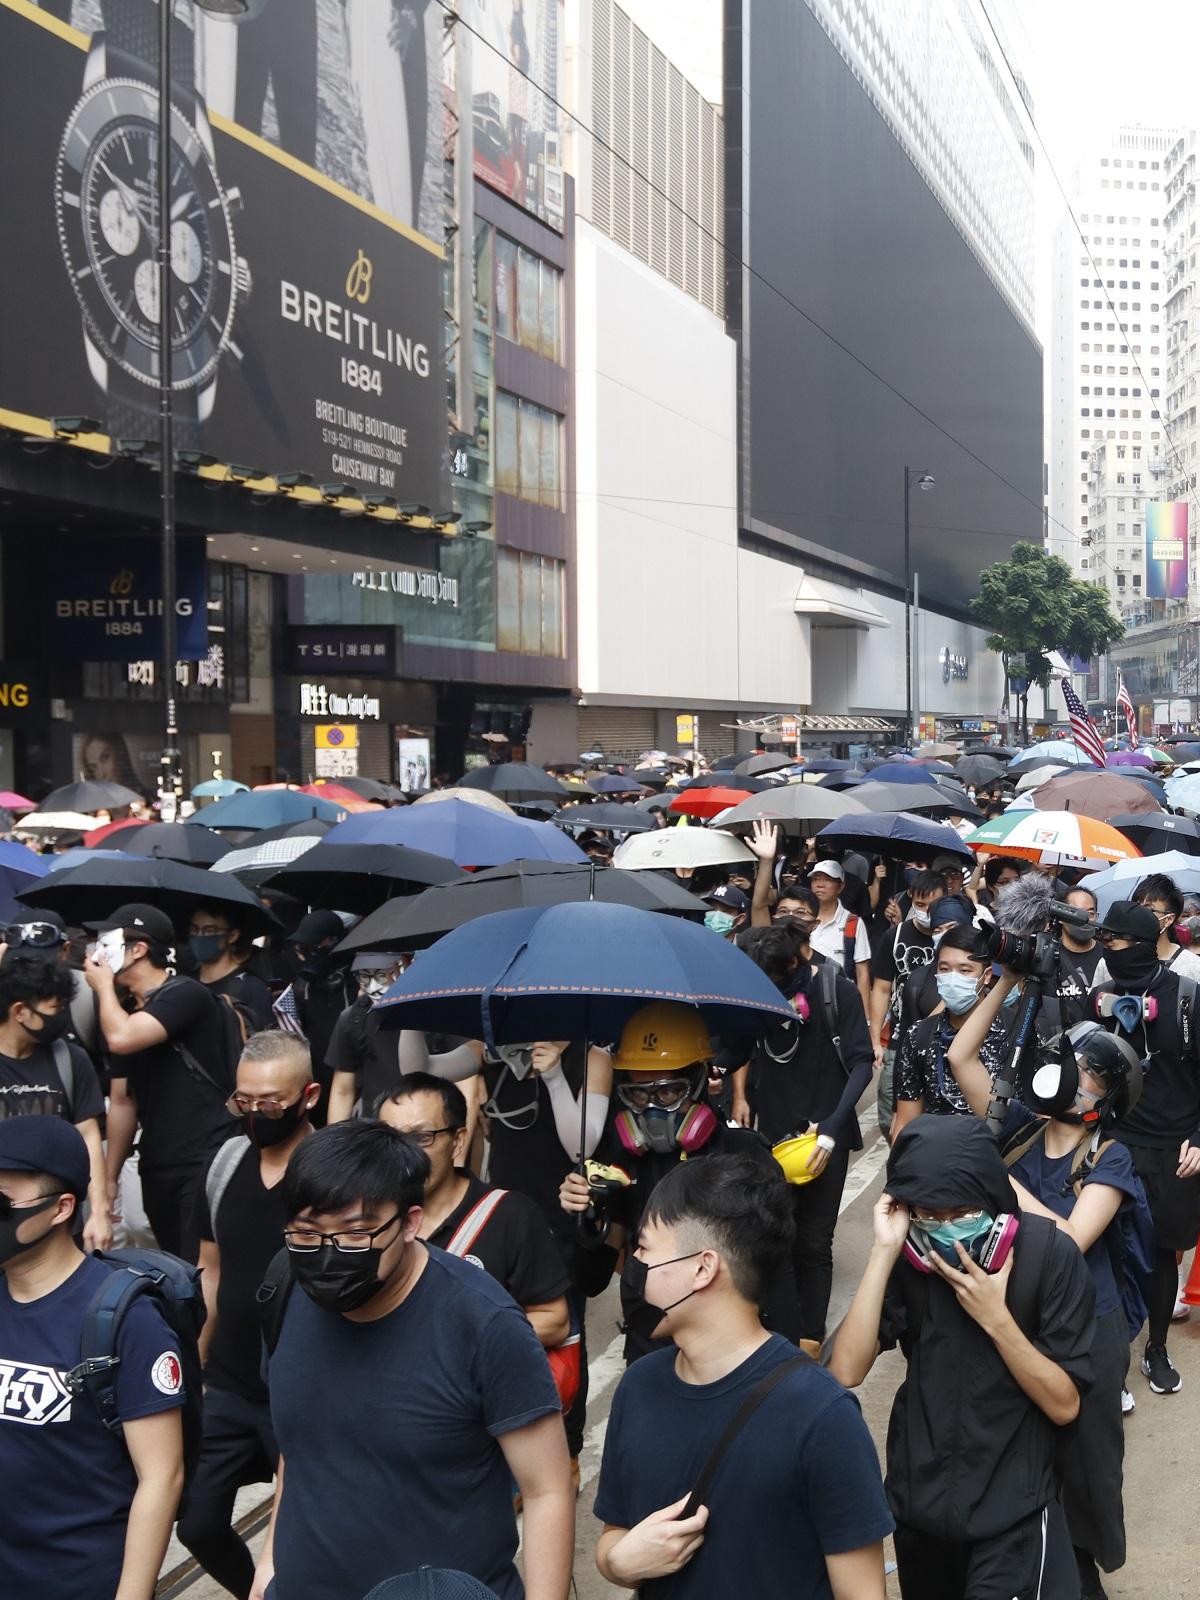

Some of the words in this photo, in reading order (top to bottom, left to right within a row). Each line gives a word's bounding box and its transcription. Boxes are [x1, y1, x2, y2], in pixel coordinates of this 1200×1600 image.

[281, 280, 430, 378] BREITLING
[341, 356, 383, 397] 1884
[315, 399, 364, 433] BREITLING
[365, 416, 408, 447] BOUTIQUE
[353, 439, 384, 461] HENNESSY
[385, 450, 402, 466] ROAD
[332, 453, 378, 483] CAUSEWAY
[379, 470, 395, 488] BAY
[105, 622, 143, 636] 1884
[297, 644, 337, 656] TSL
[300, 683, 328, 715] 周生生
